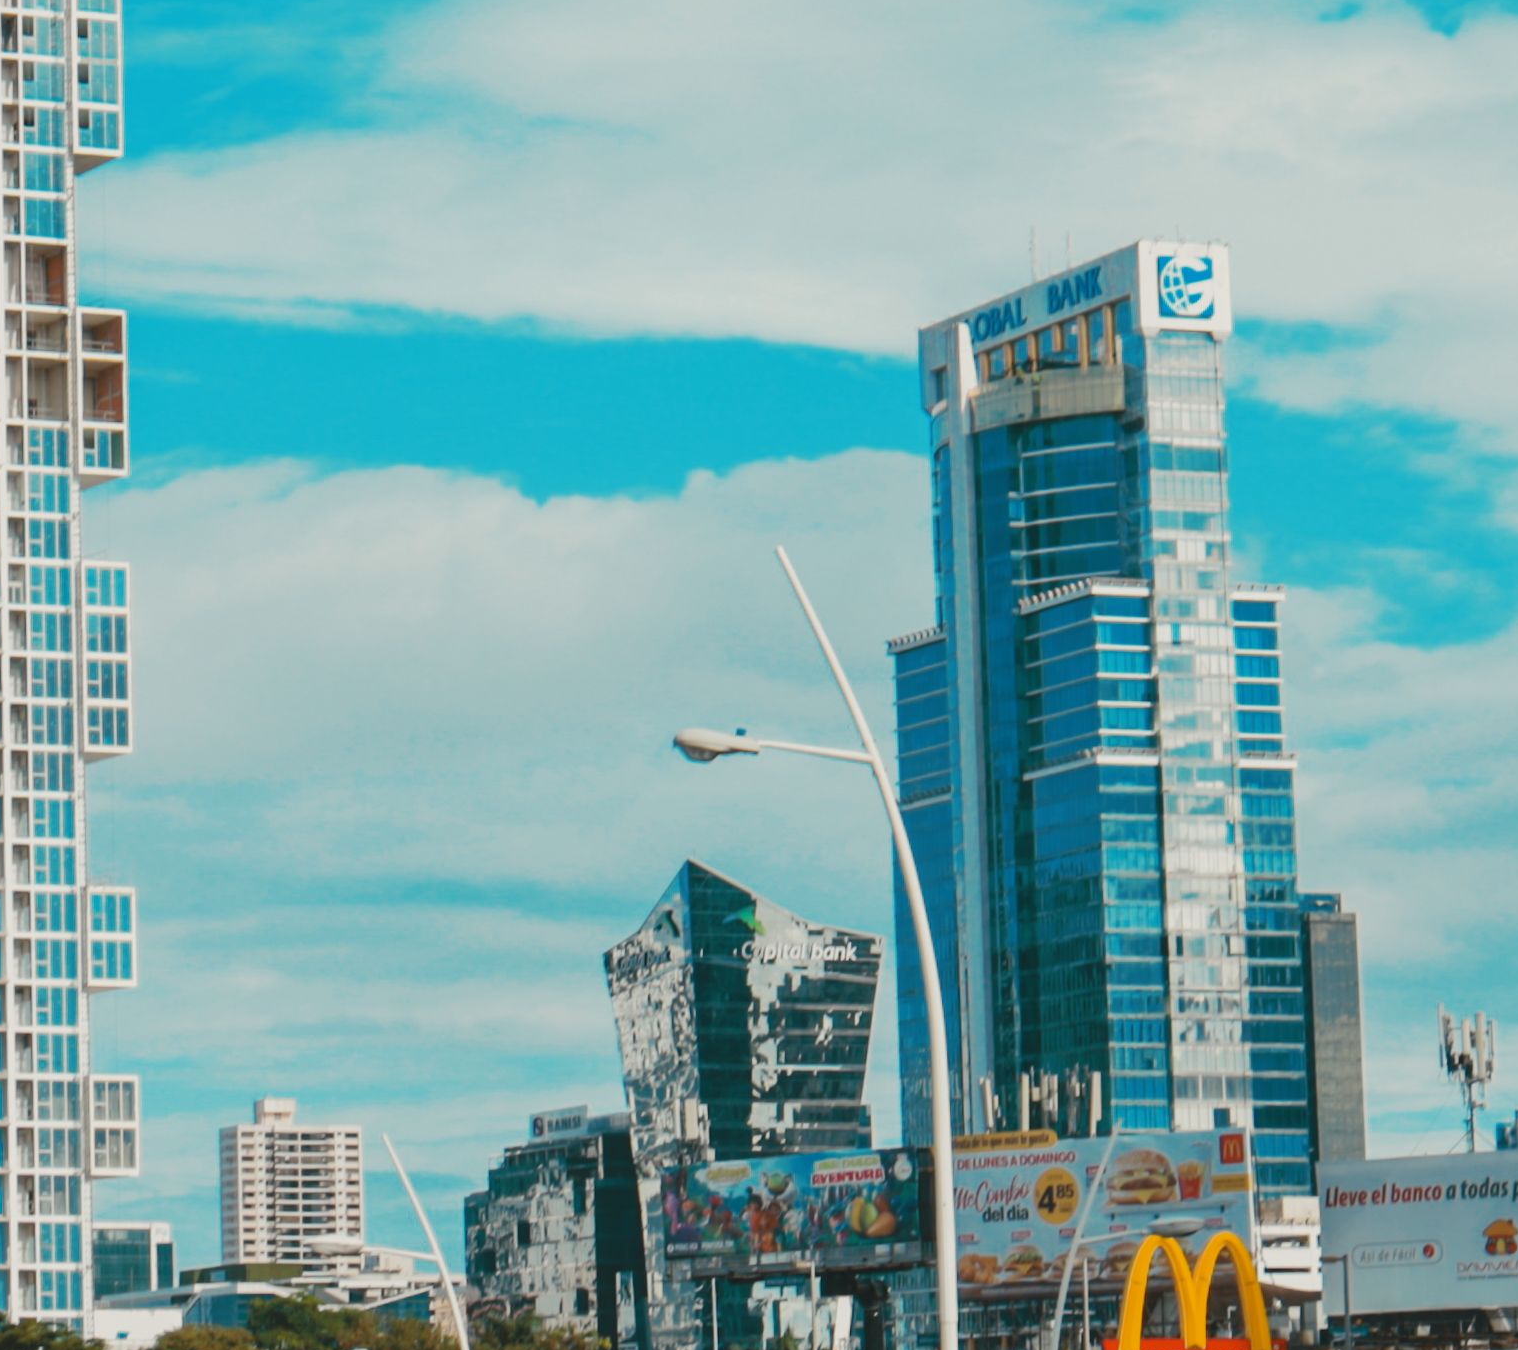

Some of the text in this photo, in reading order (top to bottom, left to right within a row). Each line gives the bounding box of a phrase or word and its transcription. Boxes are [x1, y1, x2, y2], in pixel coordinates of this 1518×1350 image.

[965, 265, 1103, 343] OBAL BANK
[811, 938, 857, 962] bank
[957, 1151, 1076, 1170] DE LUNES A DOMINGO
[812, 1168, 883, 1185] AVENTURA
[1325, 1187, 1367, 1208] Lleve
[1372, 1183, 1387, 1204] el
[1391, 1183, 1441, 1203] banco
[1446, 1185, 1456, 1200] a
[1460, 1176, 1508, 1199] todas
[982, 1207, 1003, 1223] del
